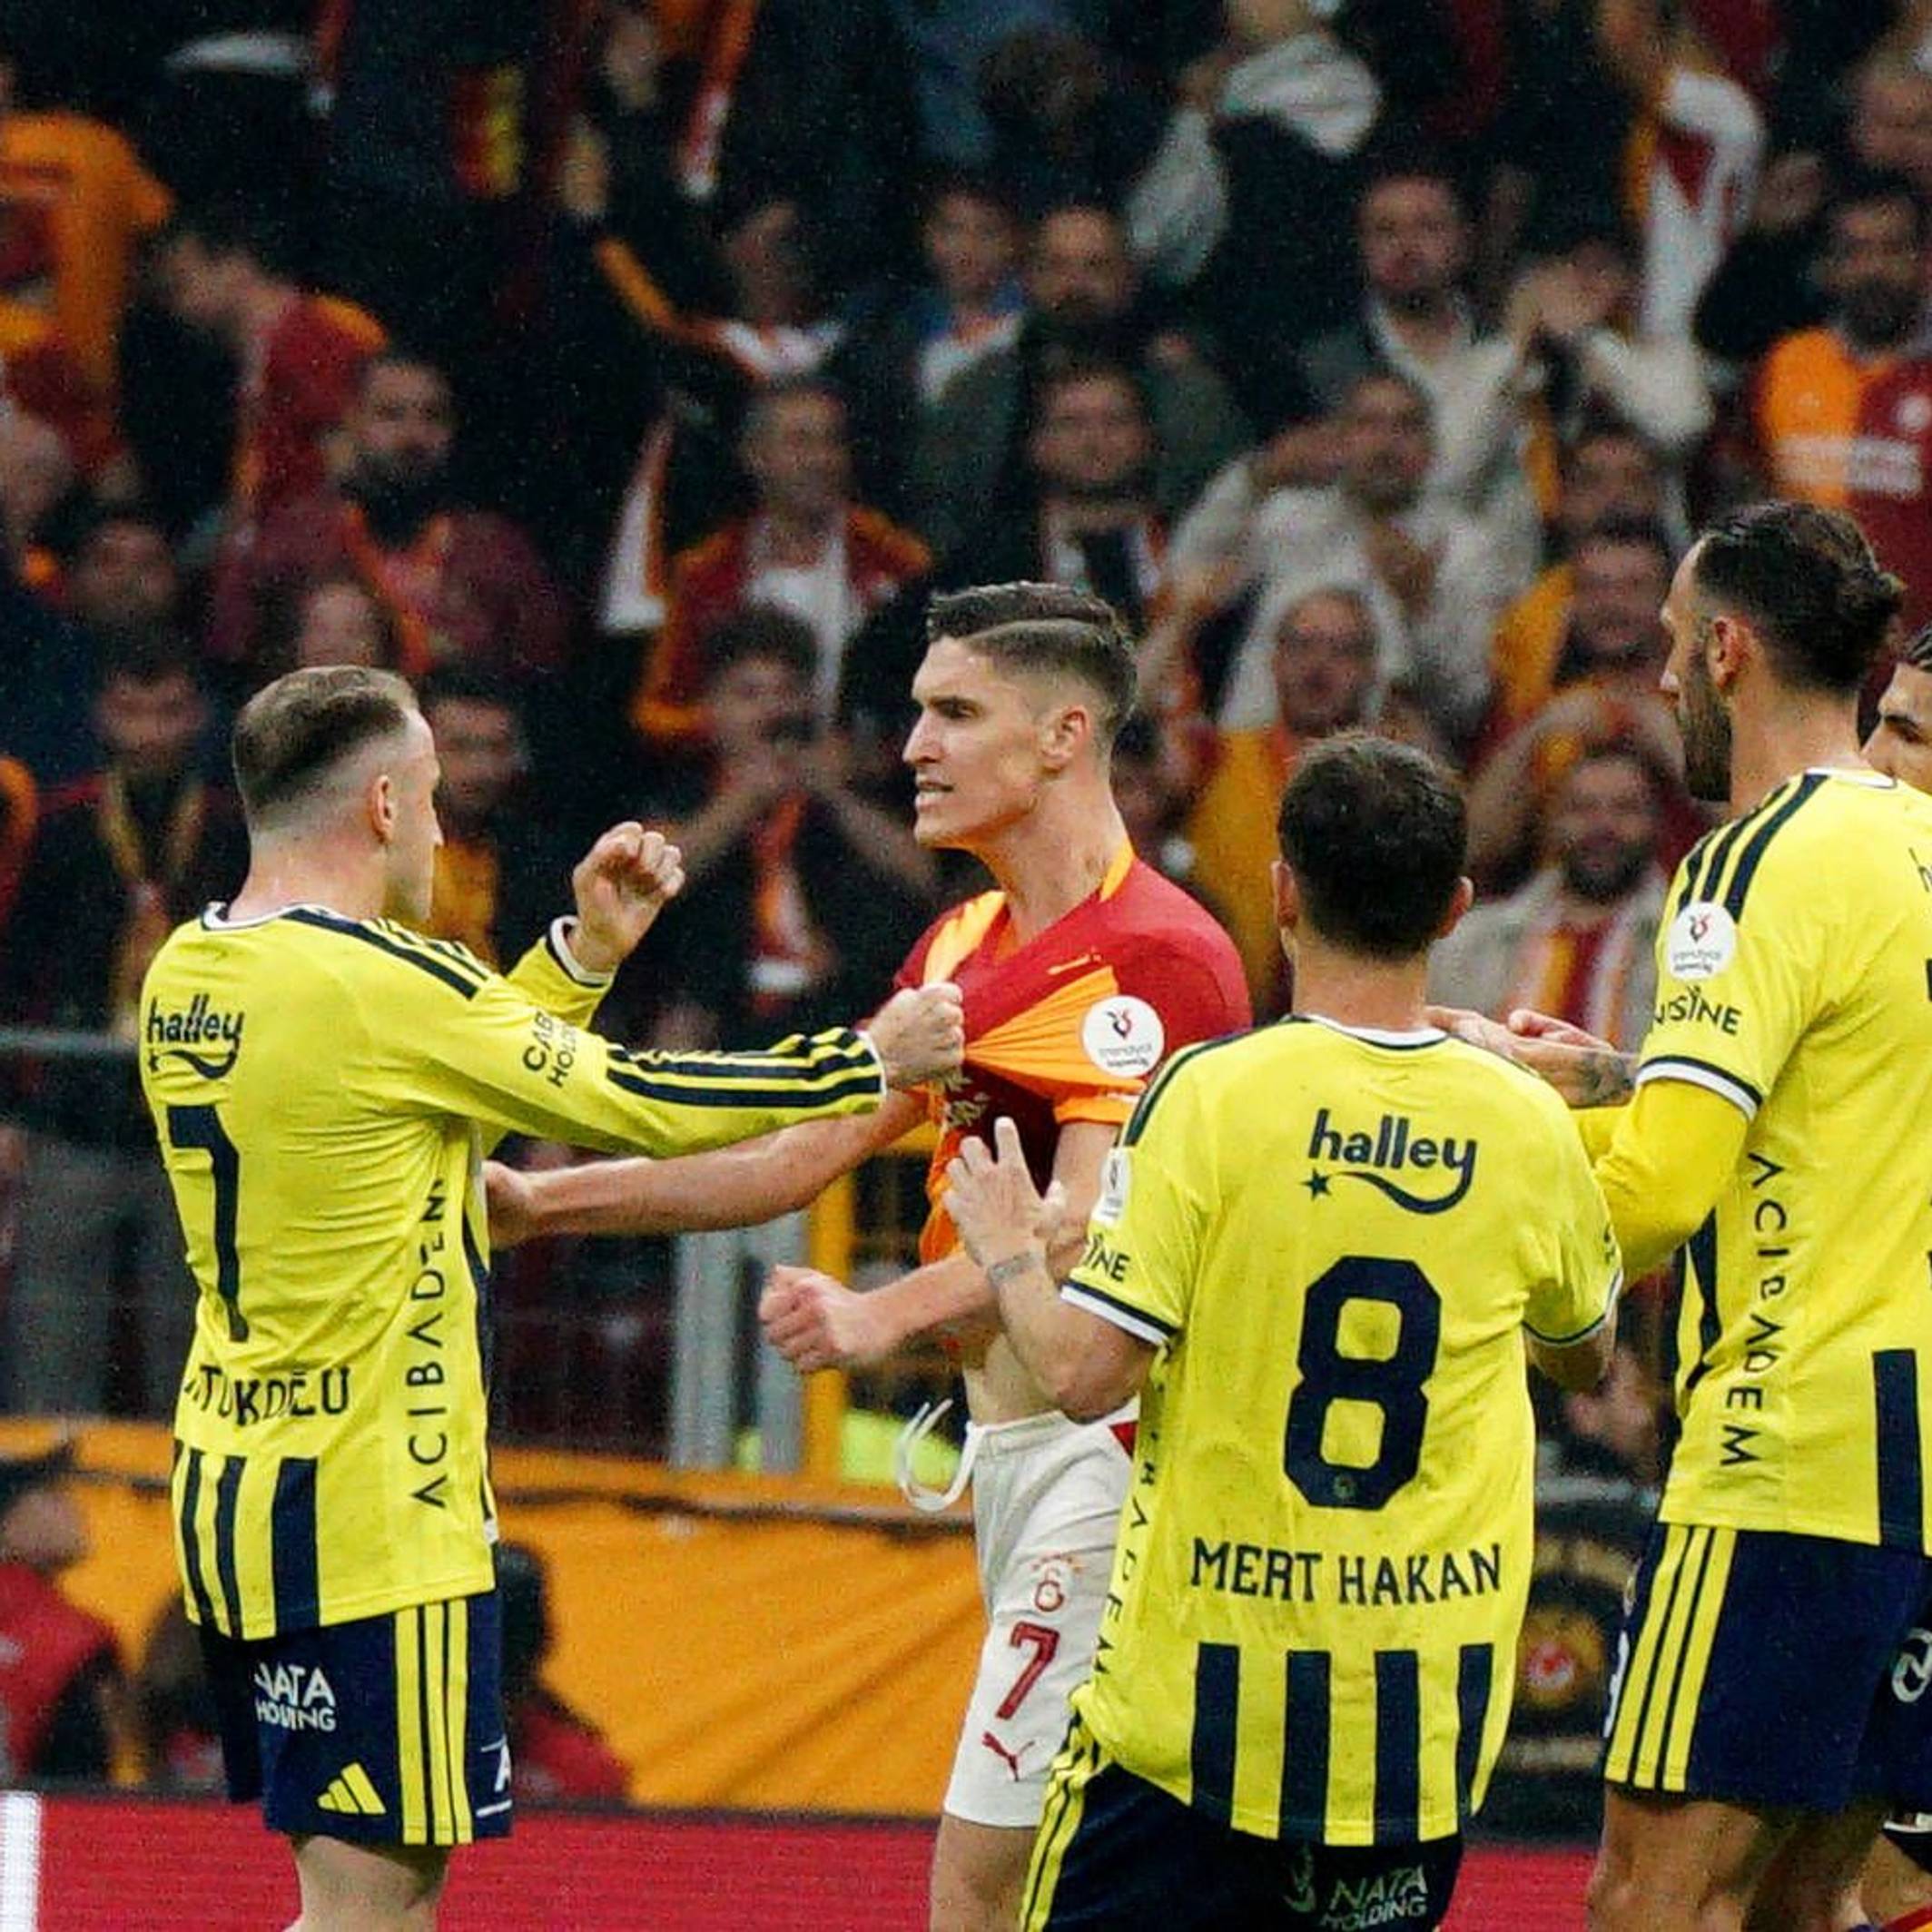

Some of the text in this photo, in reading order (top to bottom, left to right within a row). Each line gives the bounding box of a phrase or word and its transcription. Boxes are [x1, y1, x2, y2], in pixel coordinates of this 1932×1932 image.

[147, 993, 244, 1079] halley
[1308, 1109, 1477, 1214] halley
[167, 1105, 249, 1342] 7
[1284, 1255, 1442, 1512] 8
[1190, 1537, 1502, 1606] MERT HAKAN
[996, 1621, 1061, 1720] 7
[1329, 1863, 1429, 1910] NATA
